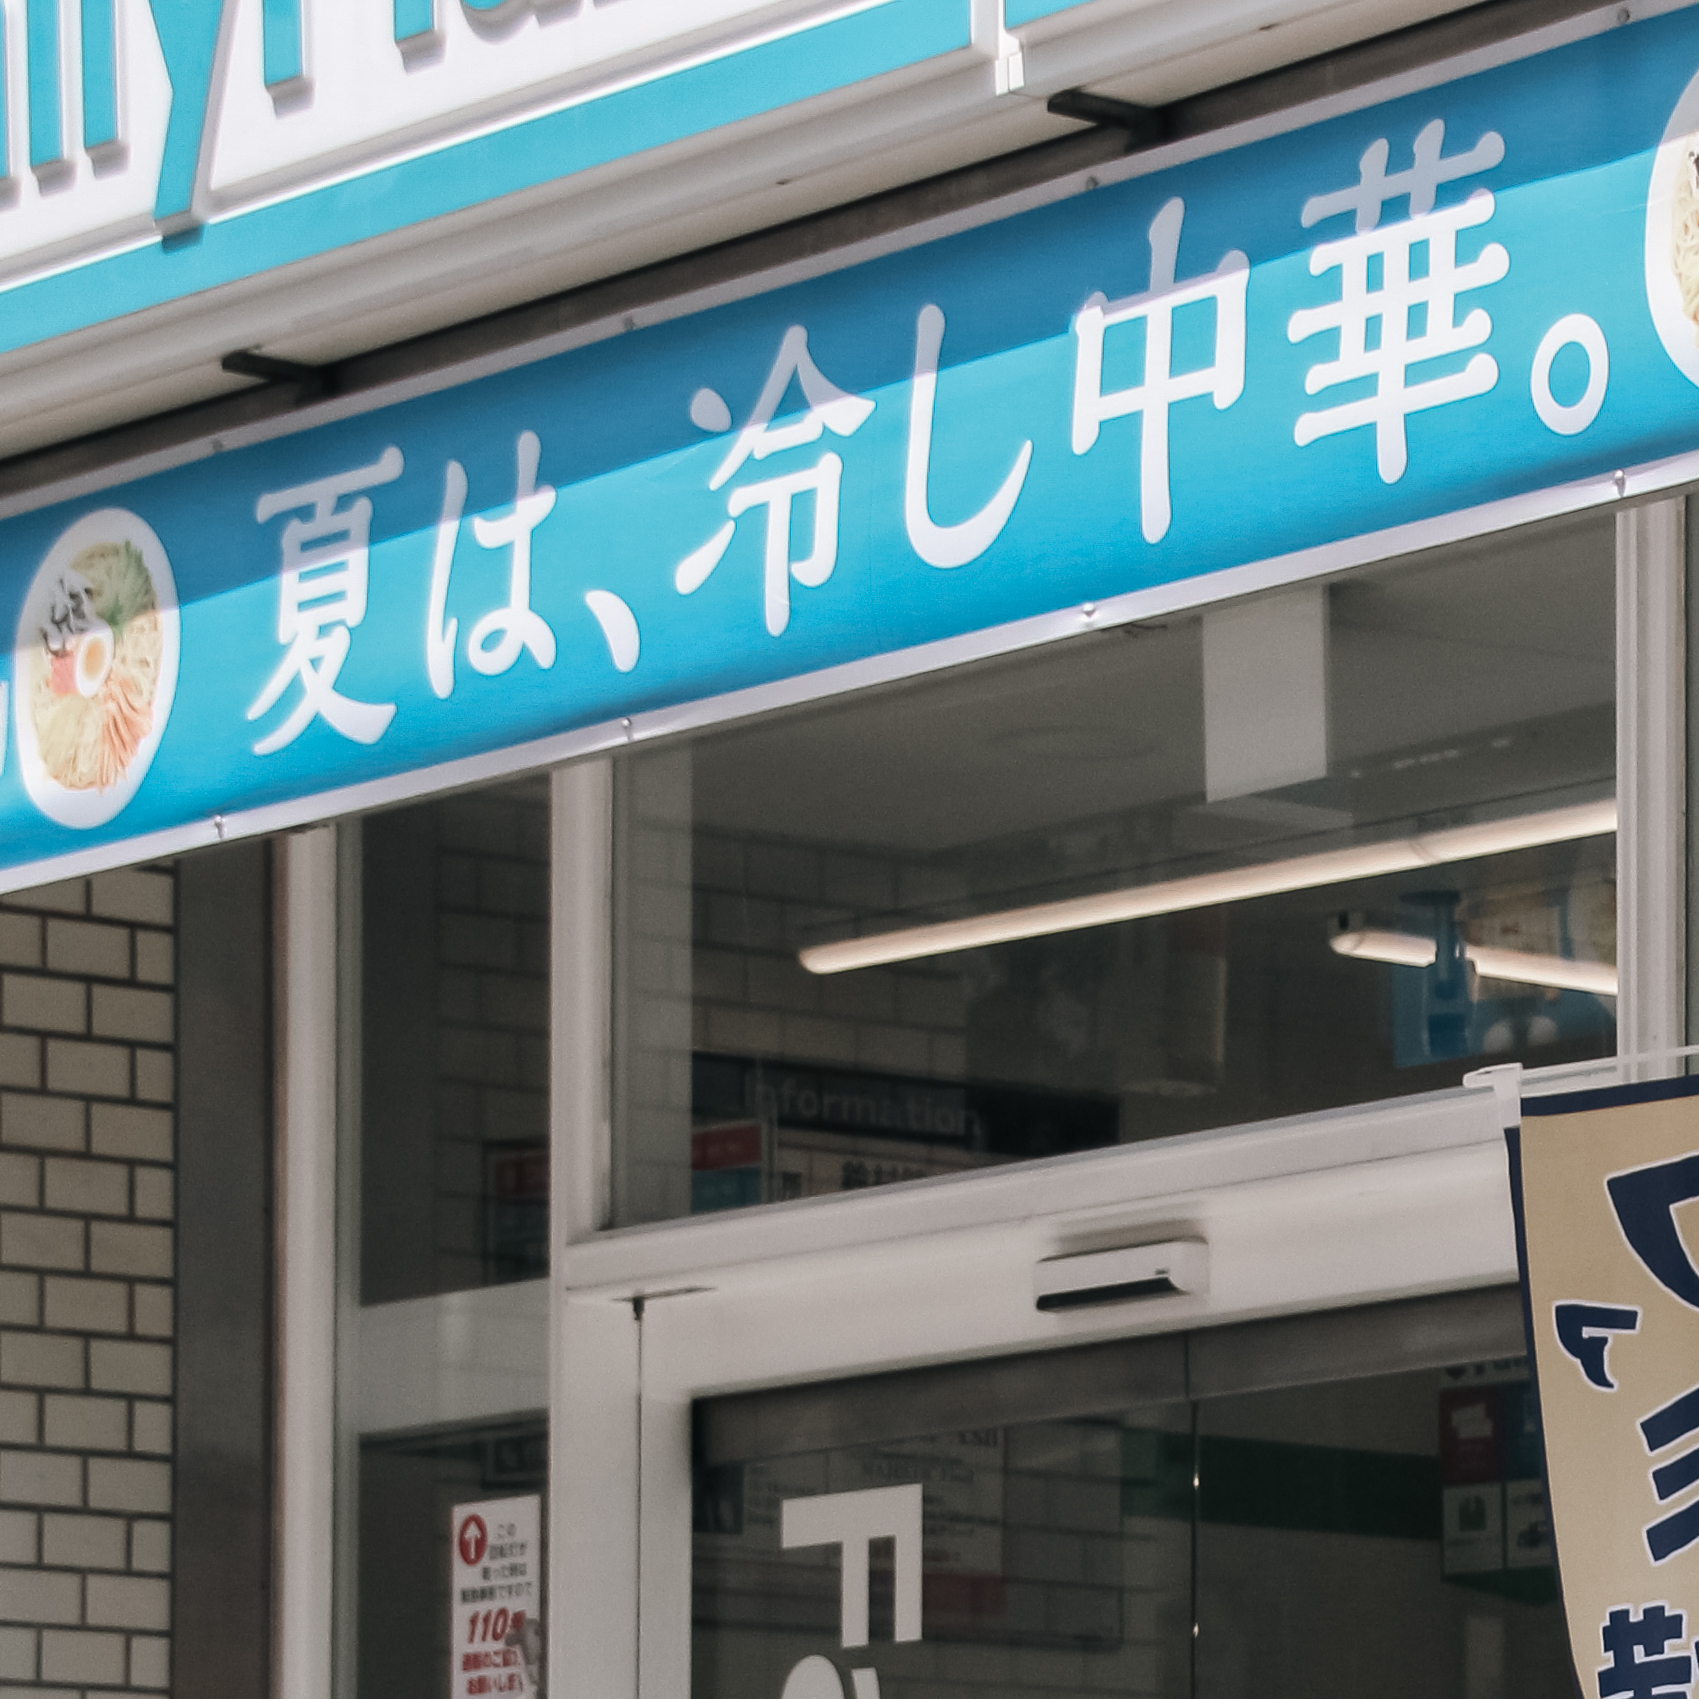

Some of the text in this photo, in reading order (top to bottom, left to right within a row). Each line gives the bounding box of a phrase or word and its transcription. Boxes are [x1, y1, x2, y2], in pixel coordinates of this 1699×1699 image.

[247, 118, 1610, 757] 夏は、冷し中華。
